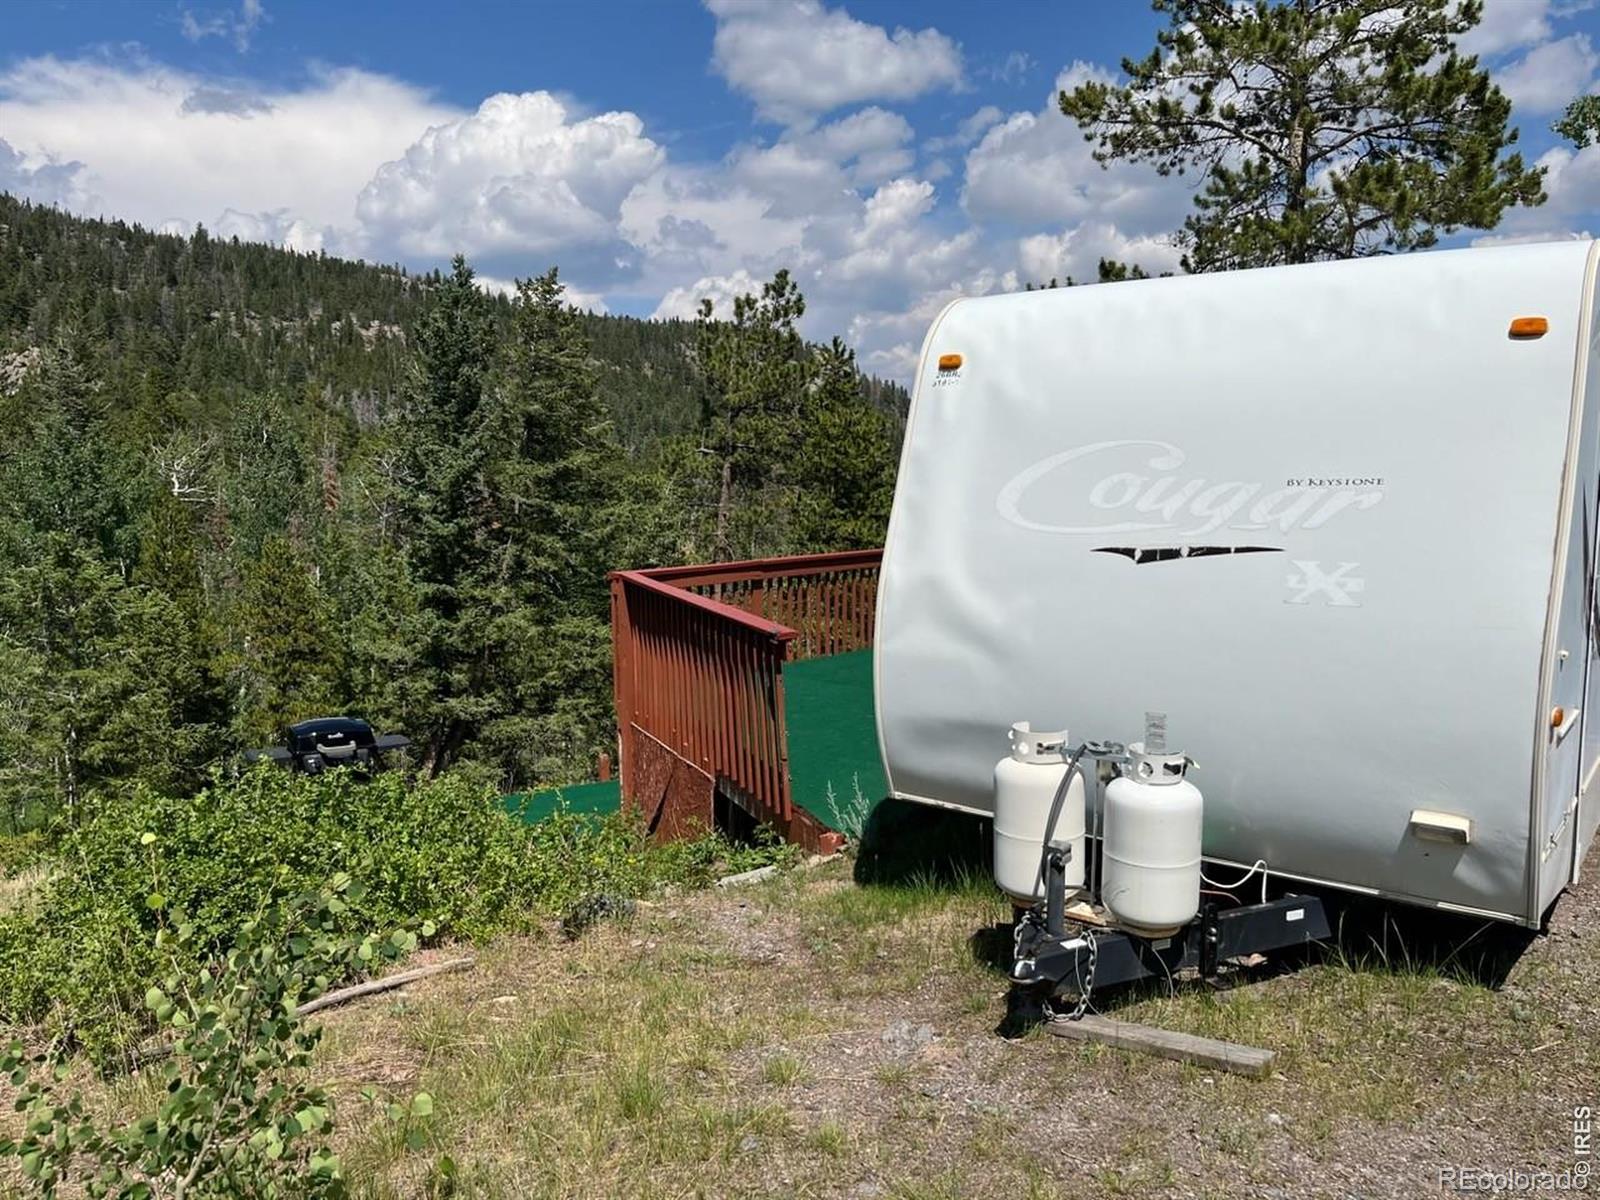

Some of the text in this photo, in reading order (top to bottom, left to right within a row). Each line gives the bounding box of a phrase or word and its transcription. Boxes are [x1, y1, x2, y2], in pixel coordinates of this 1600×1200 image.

[995, 439, 1384, 537] Cougar
[1286, 476, 1385, 488] BY KEYSTONE
